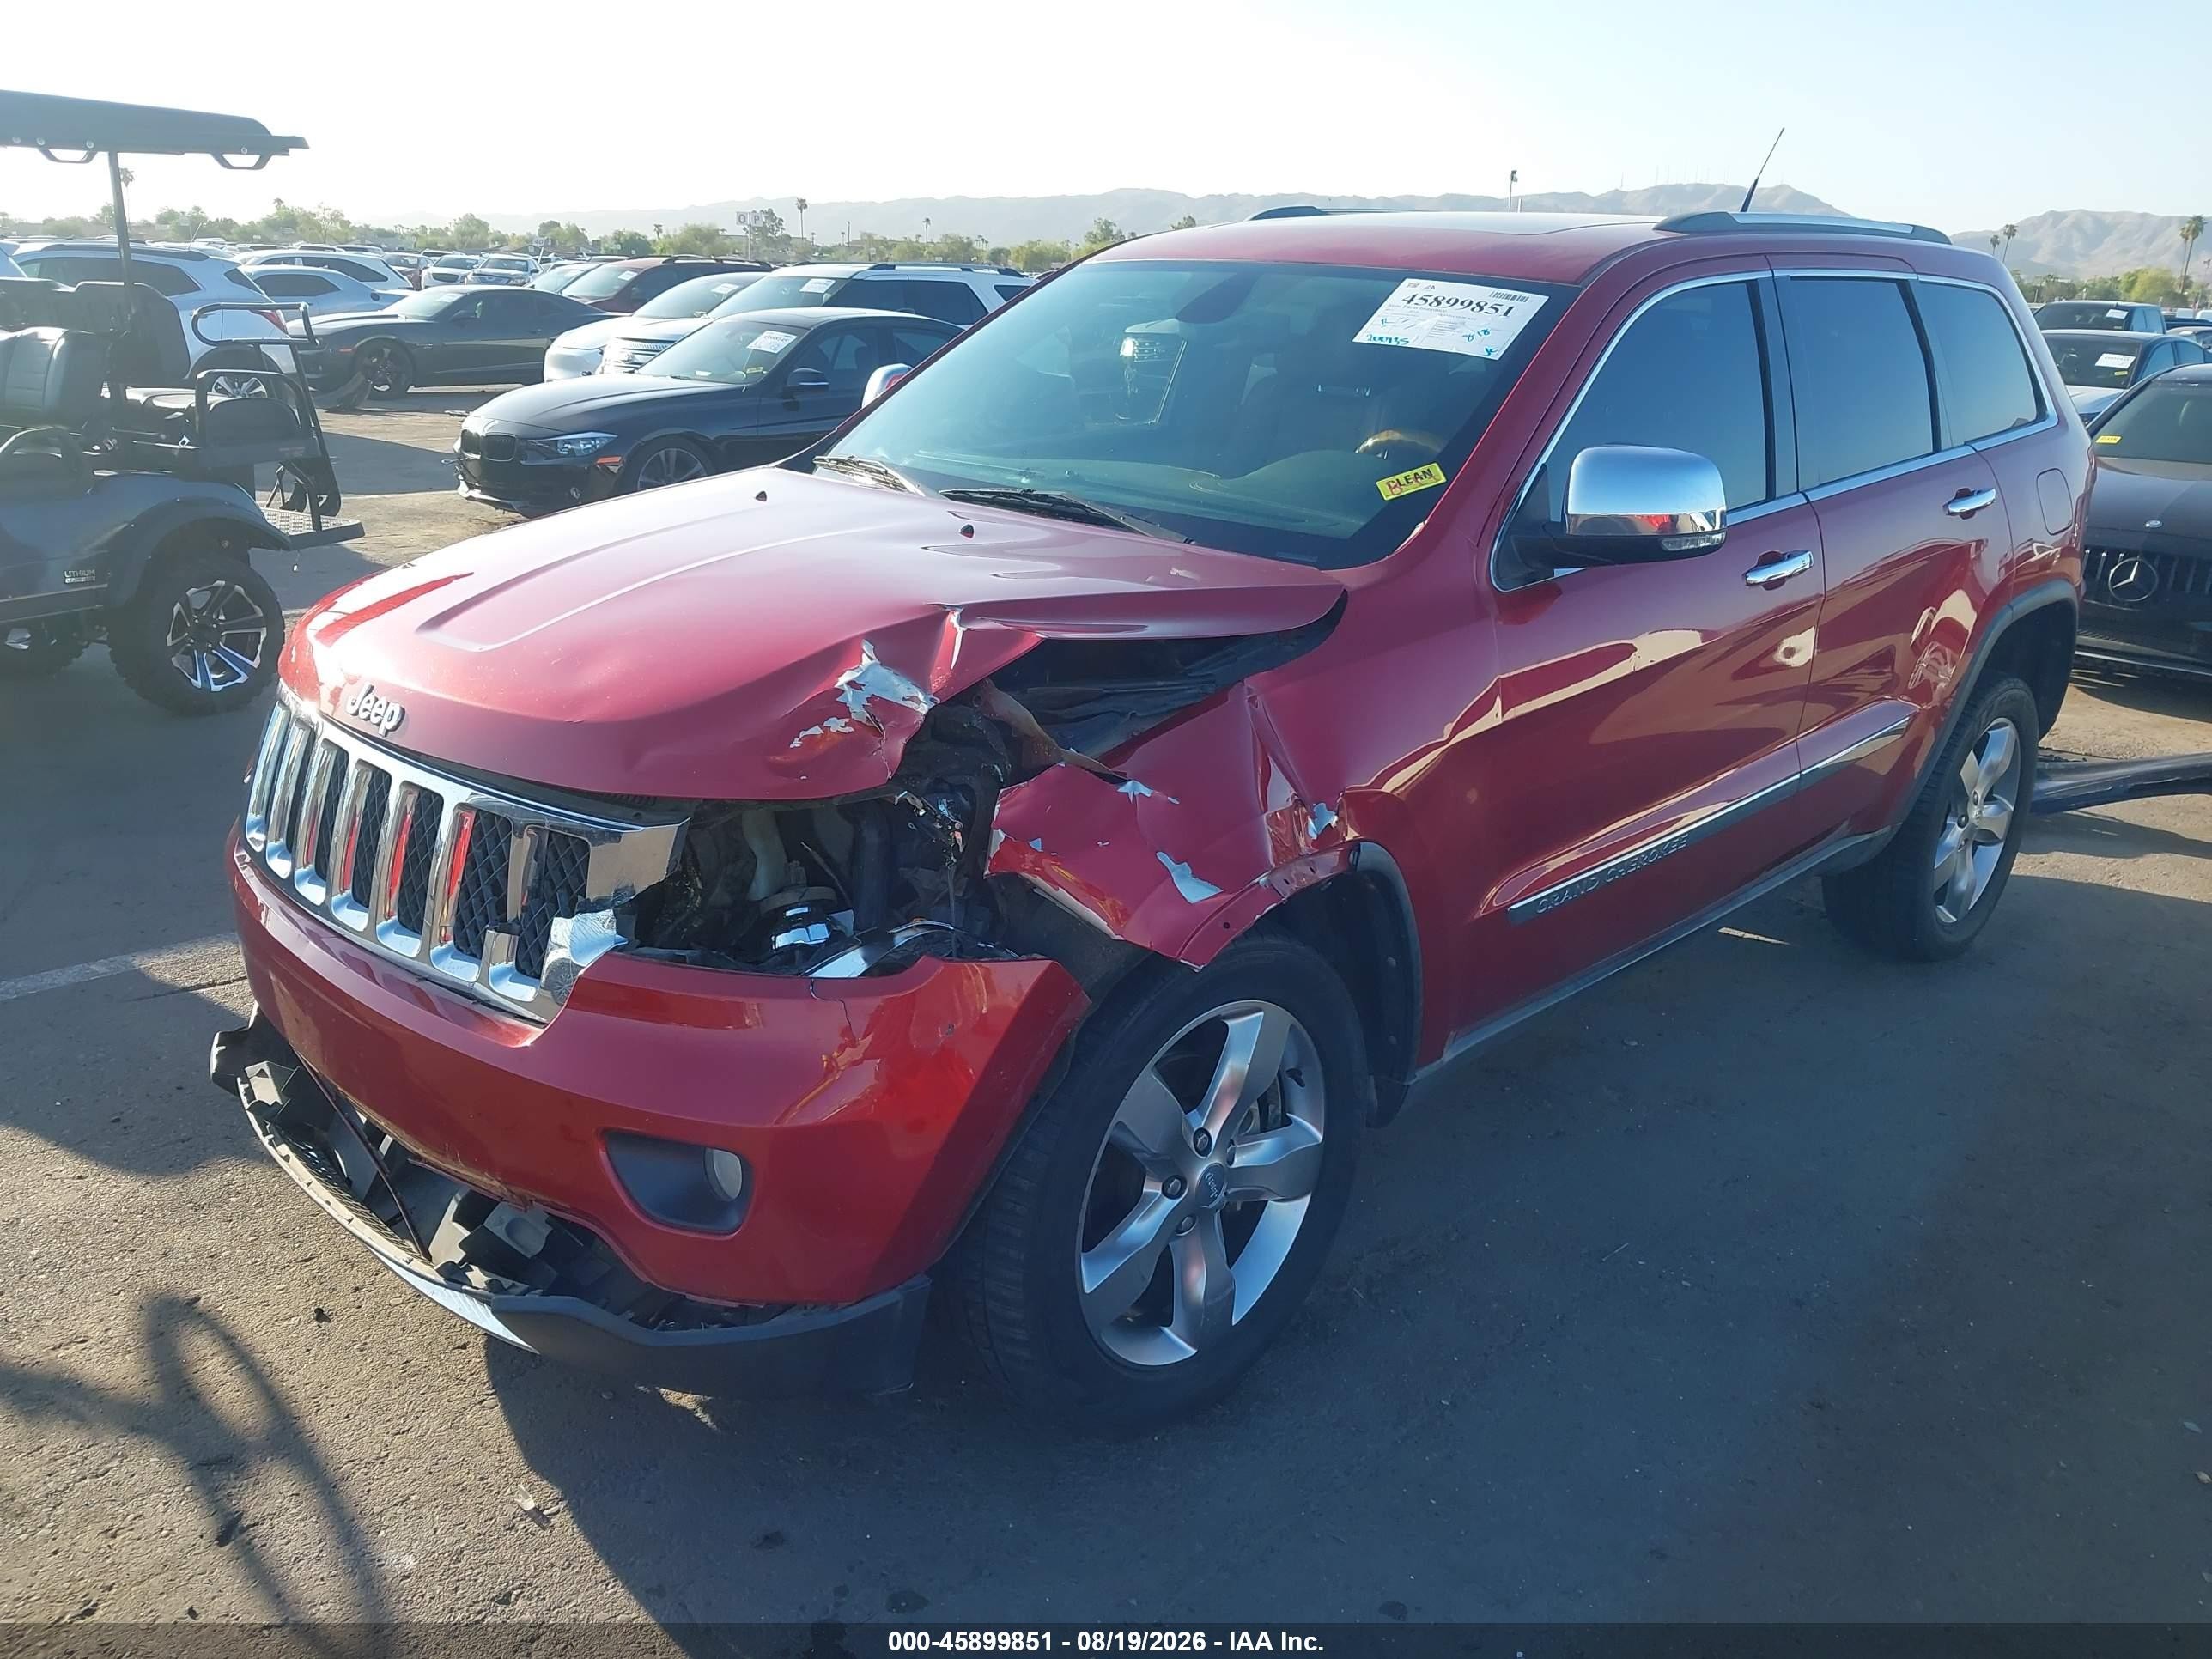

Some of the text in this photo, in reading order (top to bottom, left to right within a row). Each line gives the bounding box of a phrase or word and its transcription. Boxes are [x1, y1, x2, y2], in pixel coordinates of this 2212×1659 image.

[1401, 293, 1516, 318] 45899851
[1386, 468, 1434, 489] CLEAN
[345, 680, 406, 738] Jeep
[1537, 833, 1689, 914] GRAND CHEROKEE
